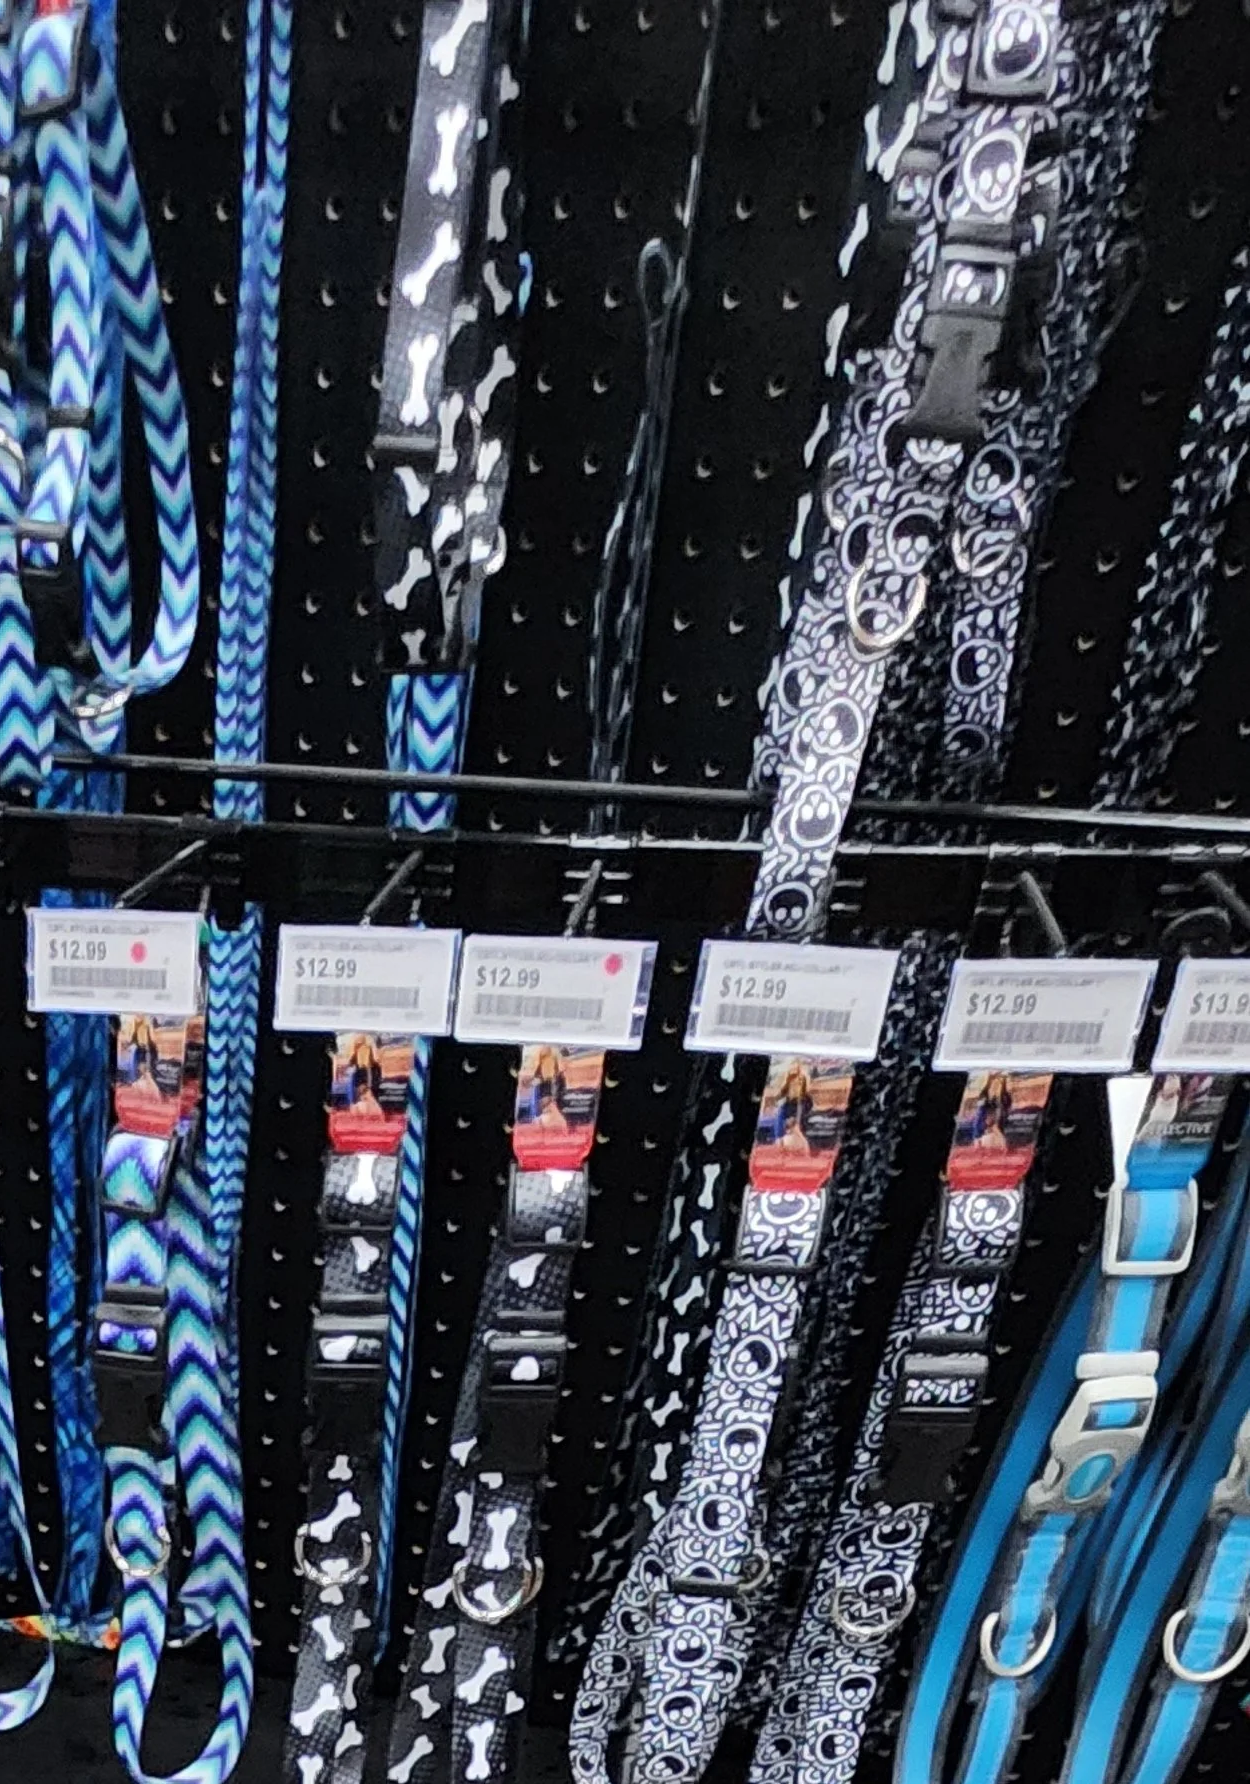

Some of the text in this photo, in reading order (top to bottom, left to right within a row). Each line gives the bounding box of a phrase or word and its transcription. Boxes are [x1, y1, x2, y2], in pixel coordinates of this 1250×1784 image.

[48, 939, 107, 961] $12.99
[295, 957, 357, 978] $12.99
[475, 965, 540, 988] $12.99
[719, 975, 788, 1000] $12.99
[966, 992, 1037, 1016] $12.99
[1190, 991, 1250, 1015] $13.9
